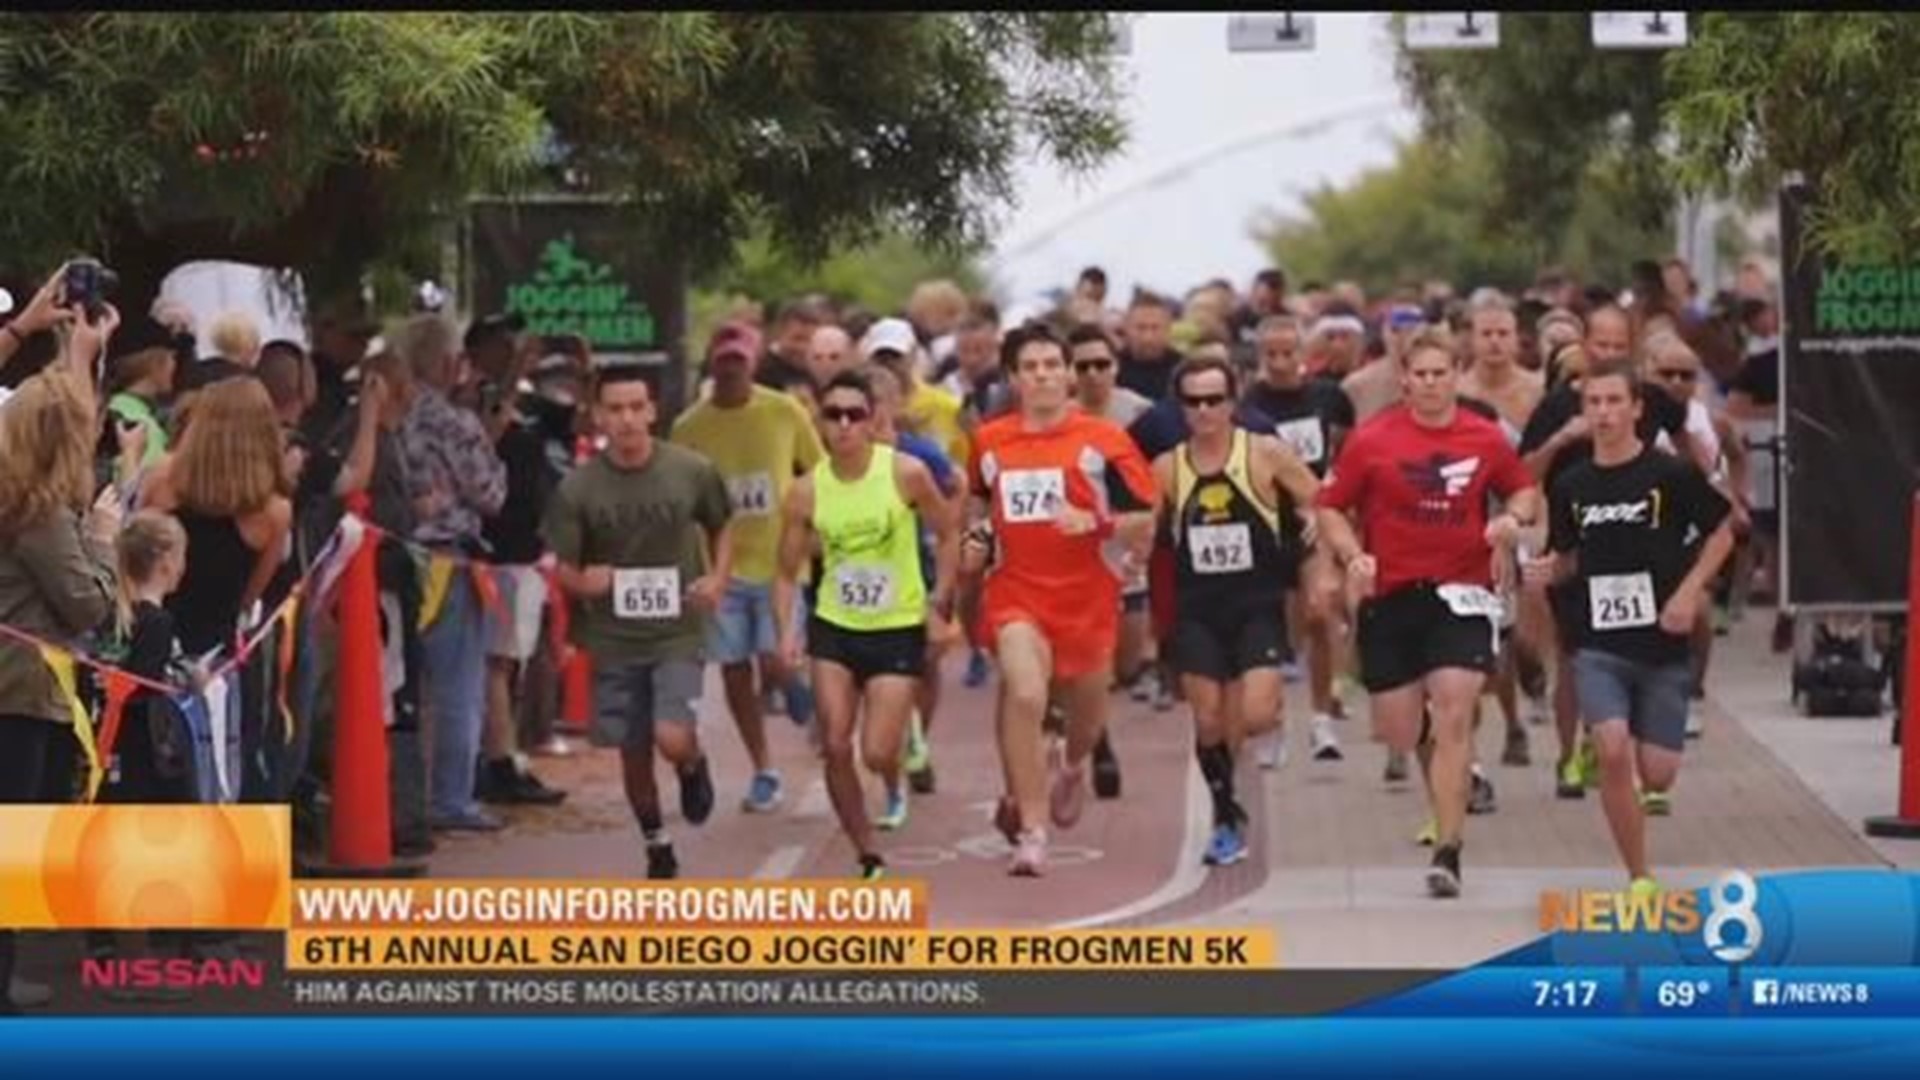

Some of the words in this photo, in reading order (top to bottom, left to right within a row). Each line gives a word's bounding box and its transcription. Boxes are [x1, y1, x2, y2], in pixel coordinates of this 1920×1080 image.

[624, 586, 670, 612] 656
[841, 582, 884, 607] 537
[1599, 595, 1643, 622] 251
